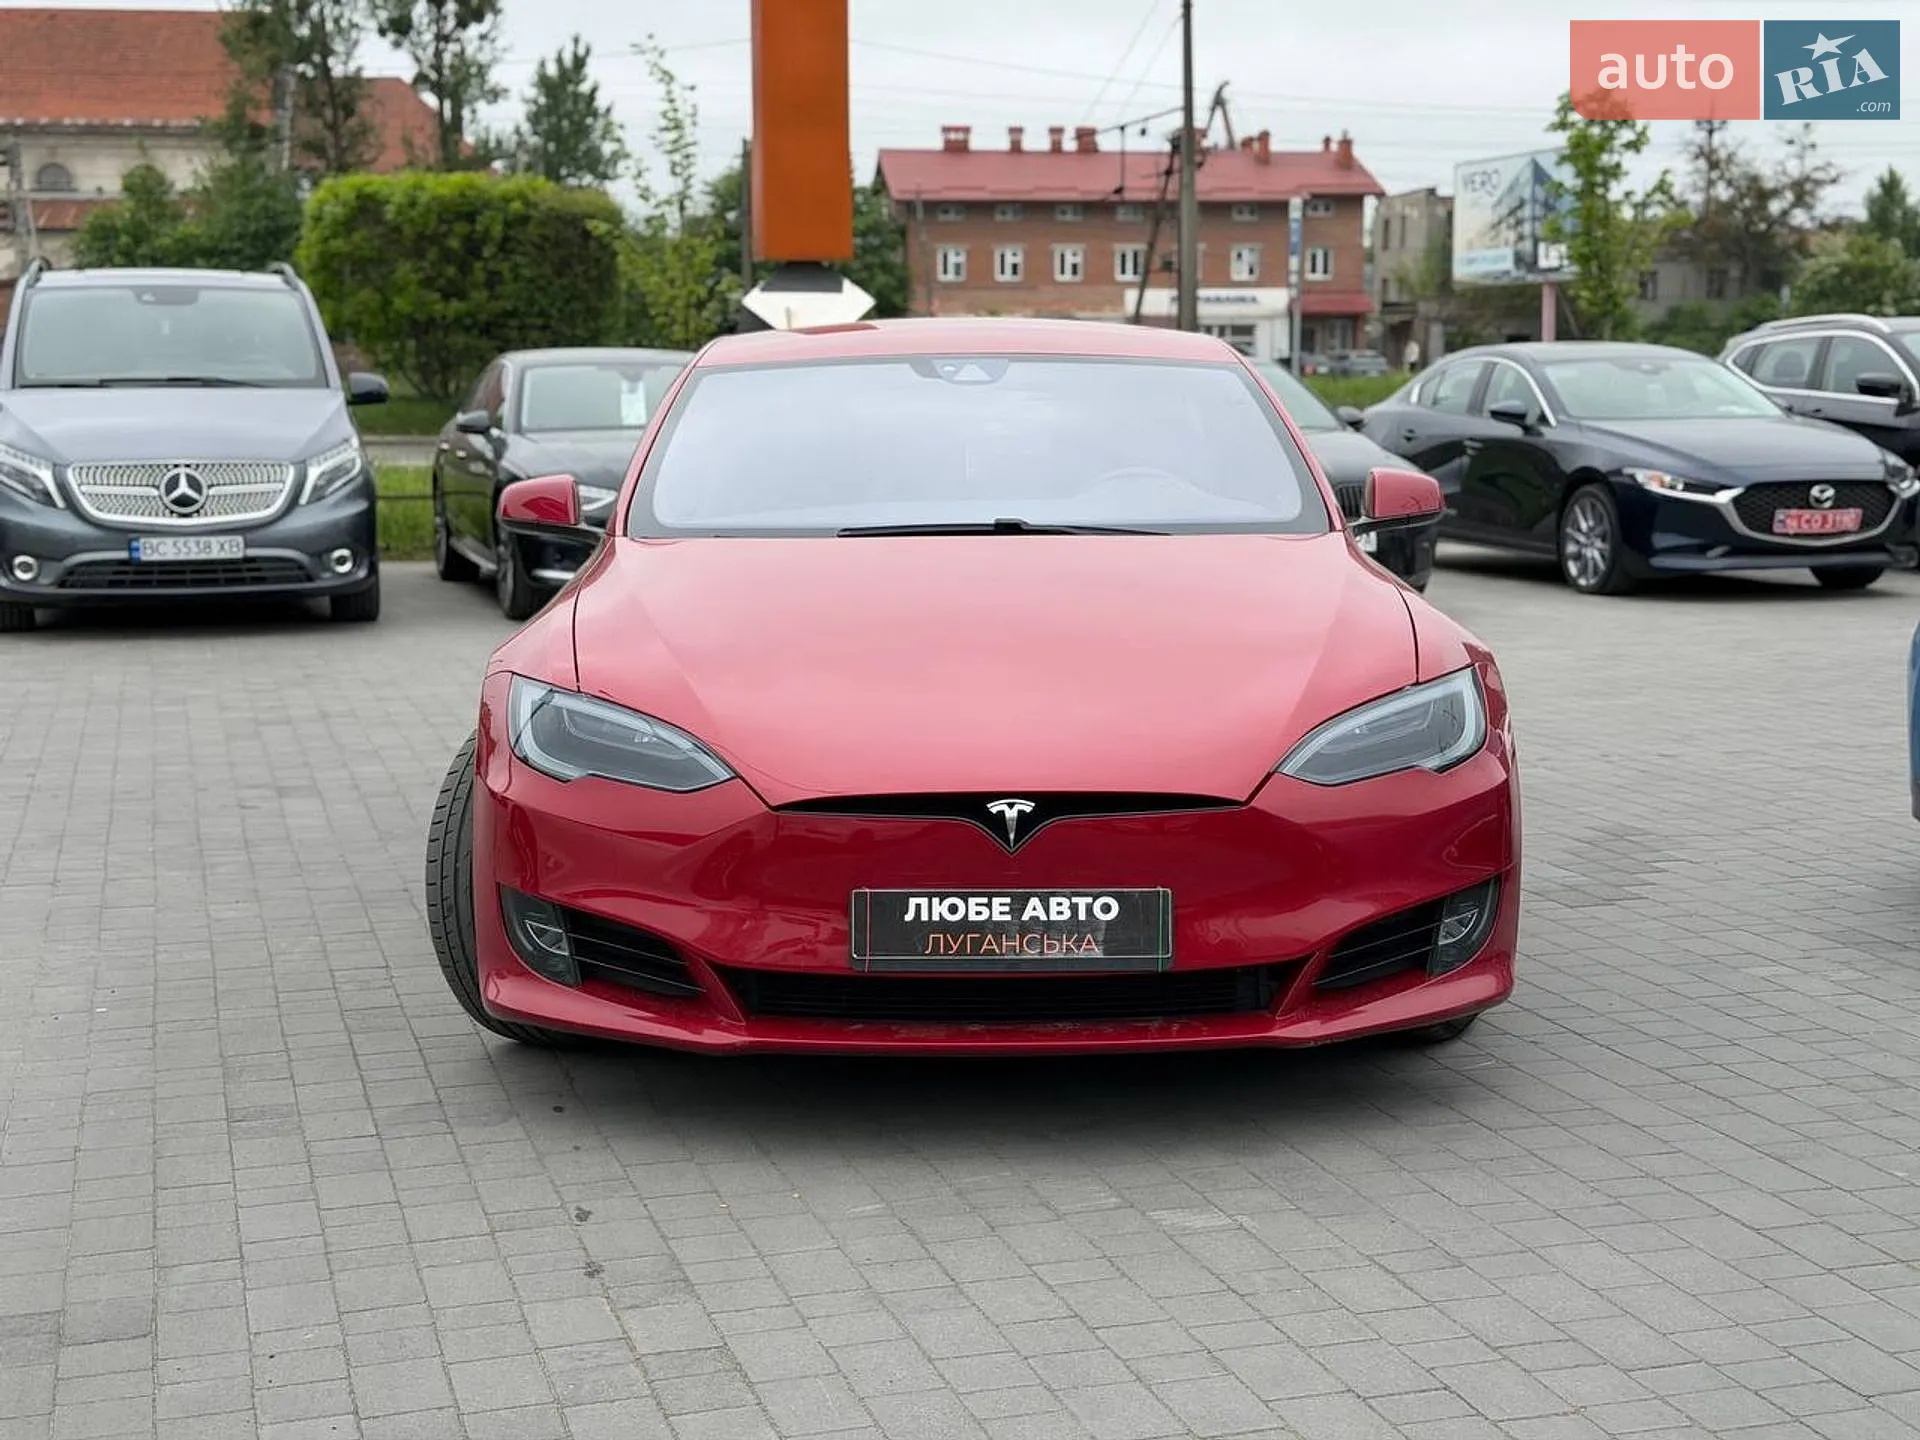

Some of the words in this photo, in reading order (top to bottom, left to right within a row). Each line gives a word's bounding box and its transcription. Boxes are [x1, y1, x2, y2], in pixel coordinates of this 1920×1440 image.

[142, 540, 168, 557] BC
[171, 539, 213, 556] 5538
[904, 896, 1012, 922] ЛЮБЕ
[1020, 896, 1120, 922] АВТО
[923, 933, 1101, 955] ЛУГАНСЬКА
